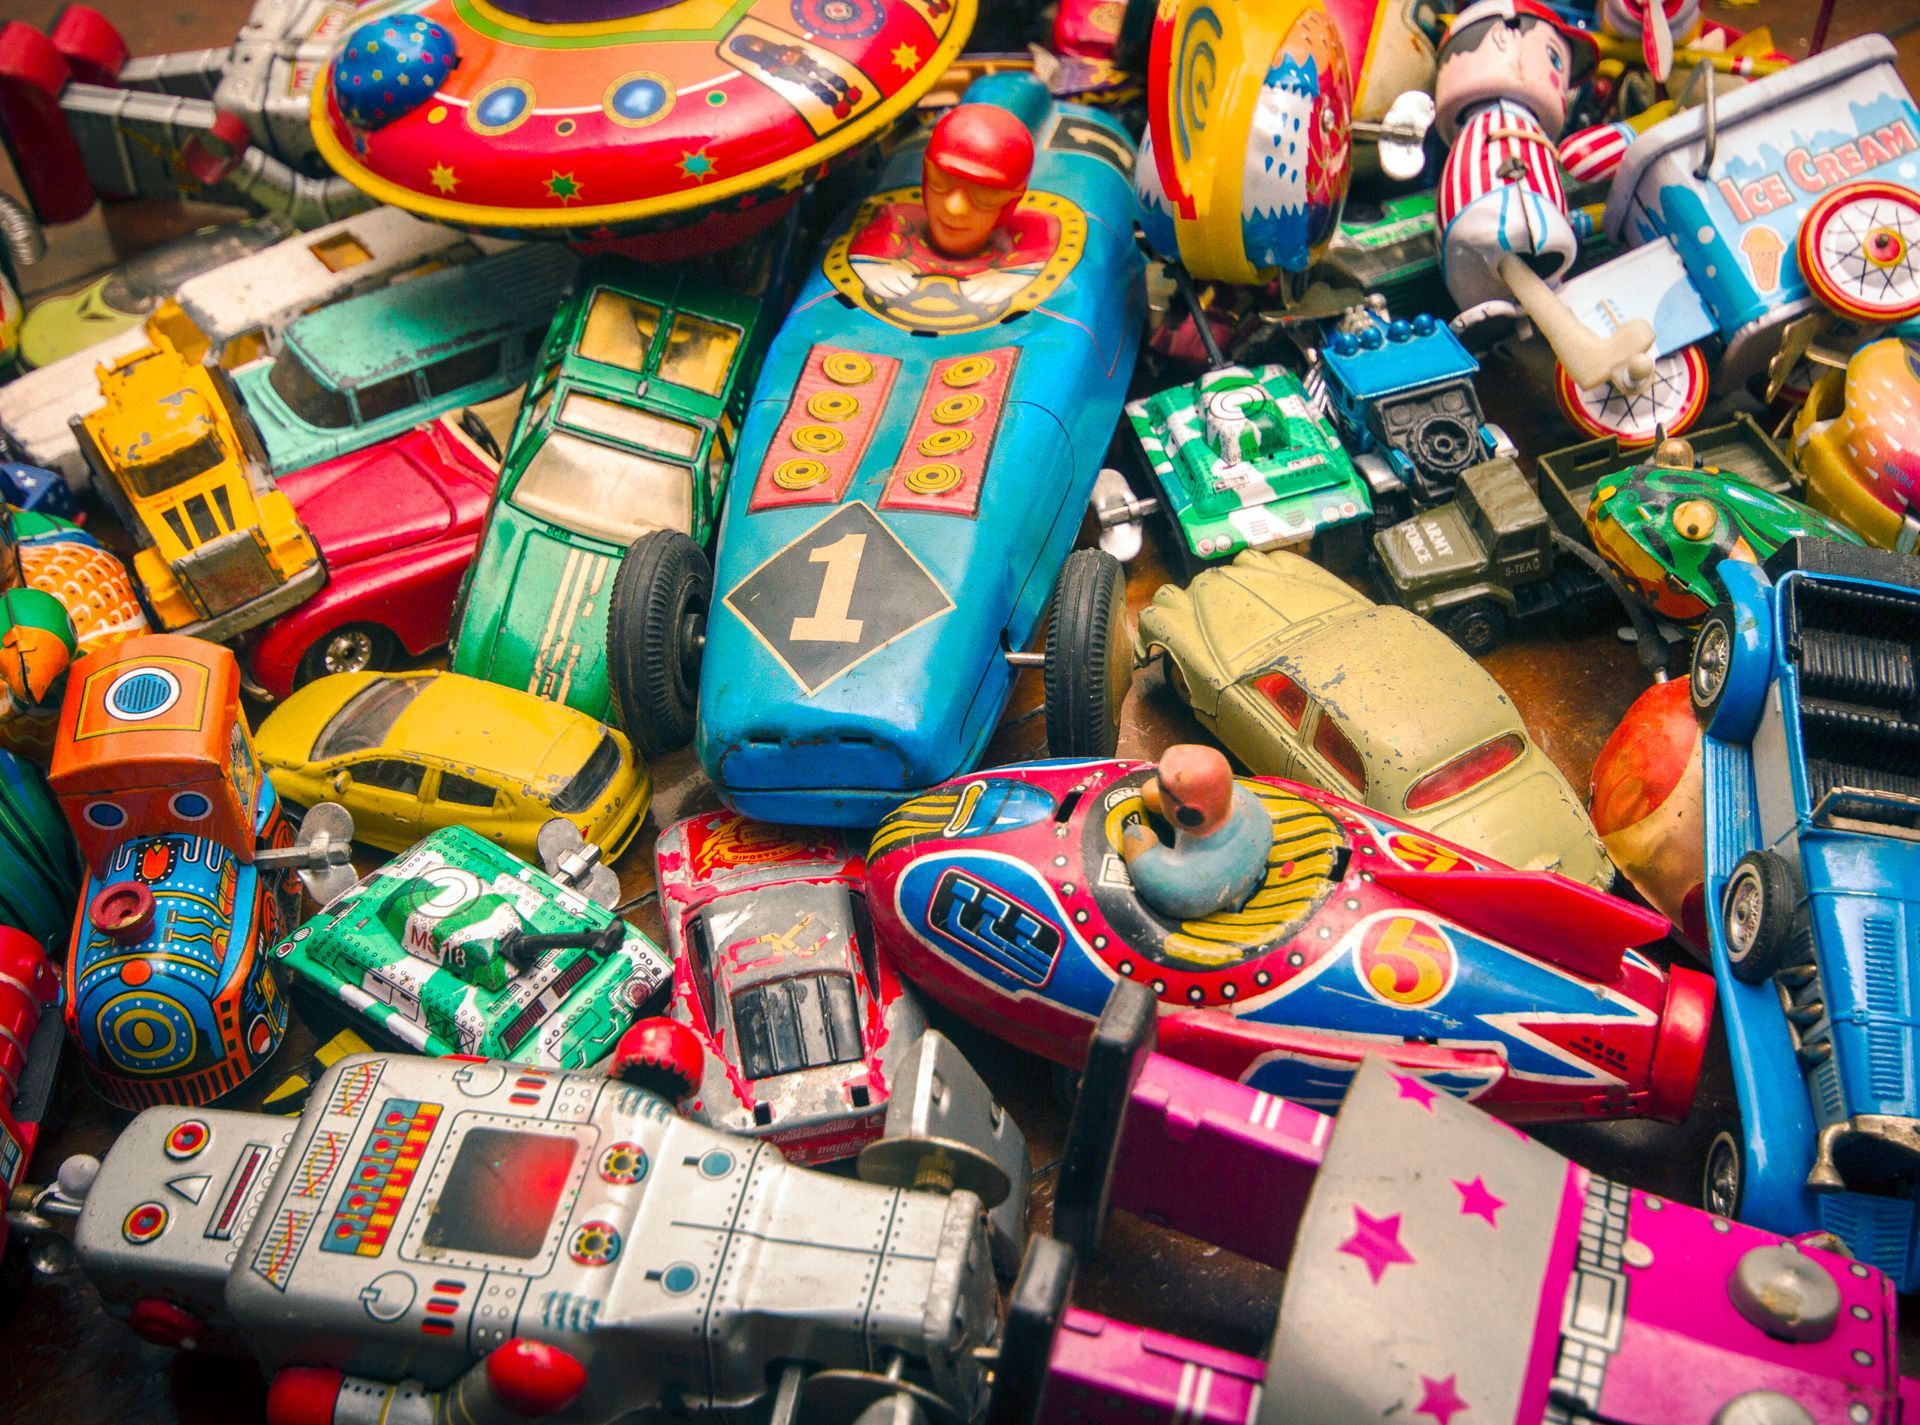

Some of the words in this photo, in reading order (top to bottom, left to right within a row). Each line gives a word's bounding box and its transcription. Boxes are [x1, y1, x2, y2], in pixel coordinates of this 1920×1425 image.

[1401, 523, 1433, 565] FORCE
[1422, 521, 1454, 557] ARMY
[789, 533, 867, 643] 1
[1368, 917, 1450, 1005] 5
